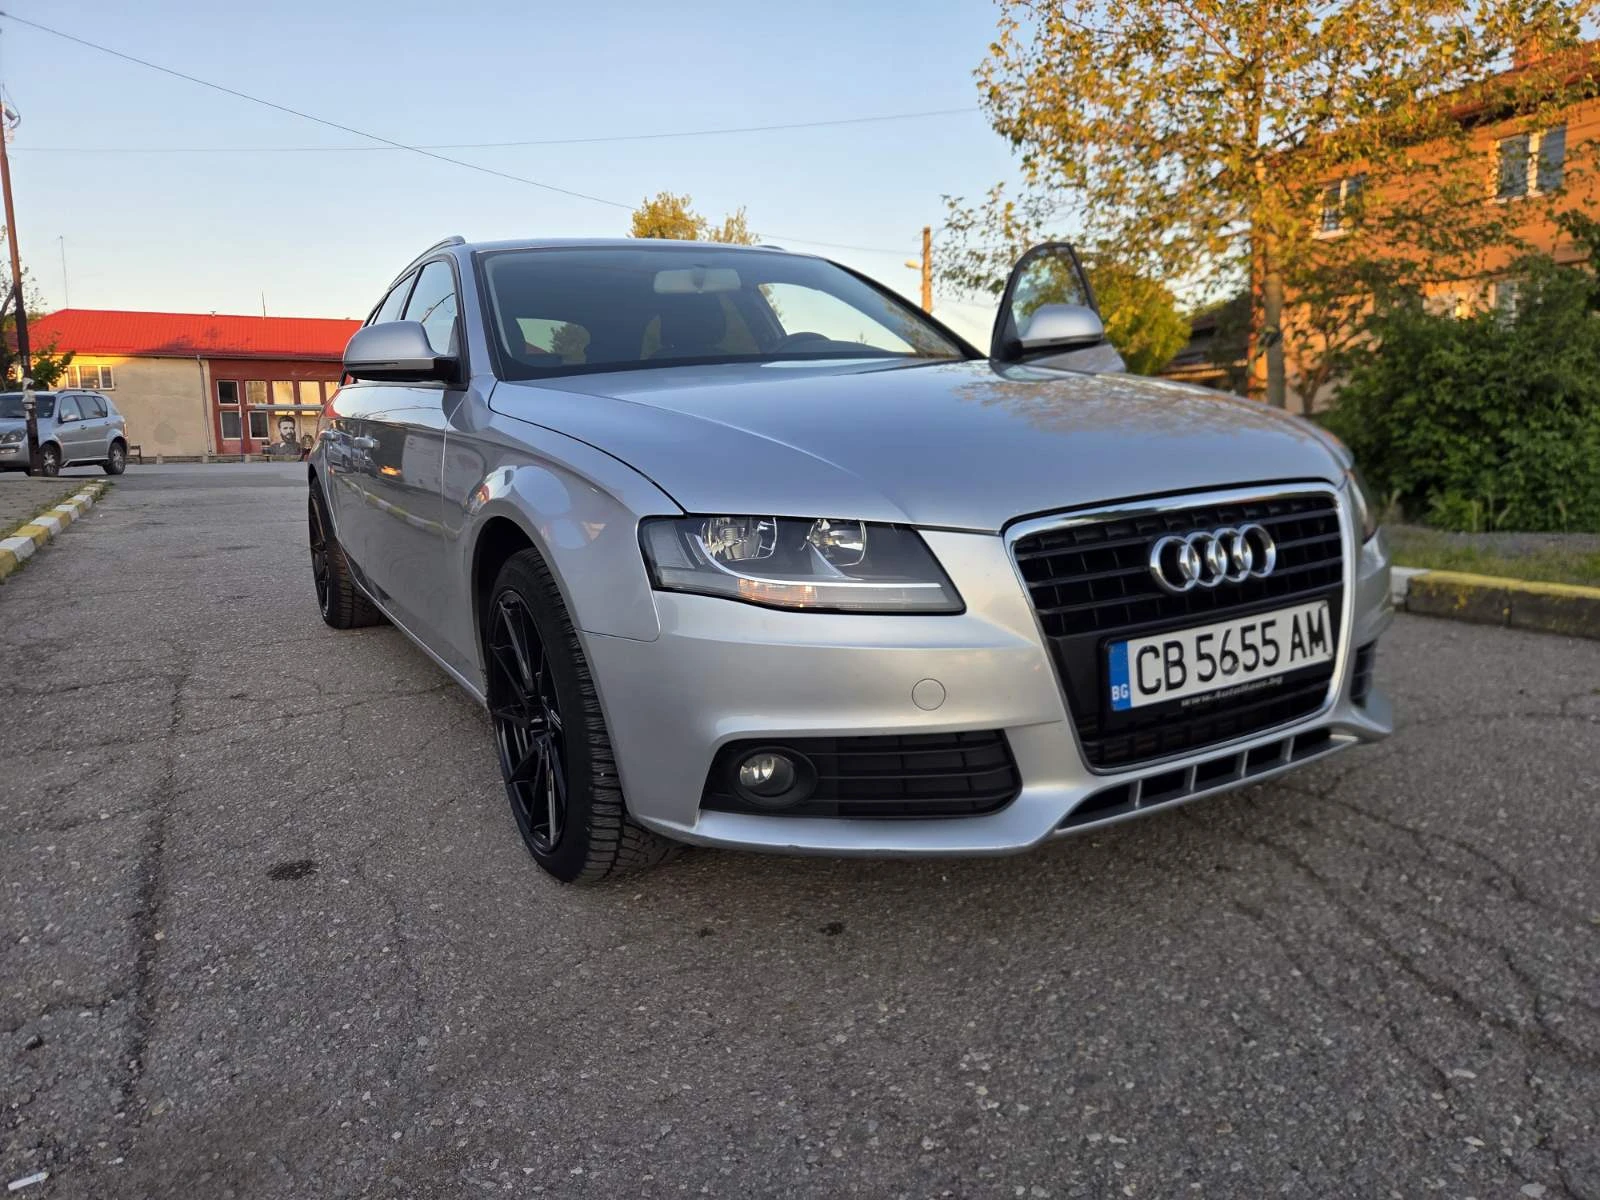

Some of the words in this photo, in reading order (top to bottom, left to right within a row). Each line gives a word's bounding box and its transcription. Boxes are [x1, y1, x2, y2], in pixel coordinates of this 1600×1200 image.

[1136, 640, 1187, 696] CB
[1195, 620, 1280, 682] 5655
[1290, 604, 1328, 662] AM
[1111, 684, 1129, 701] BG
